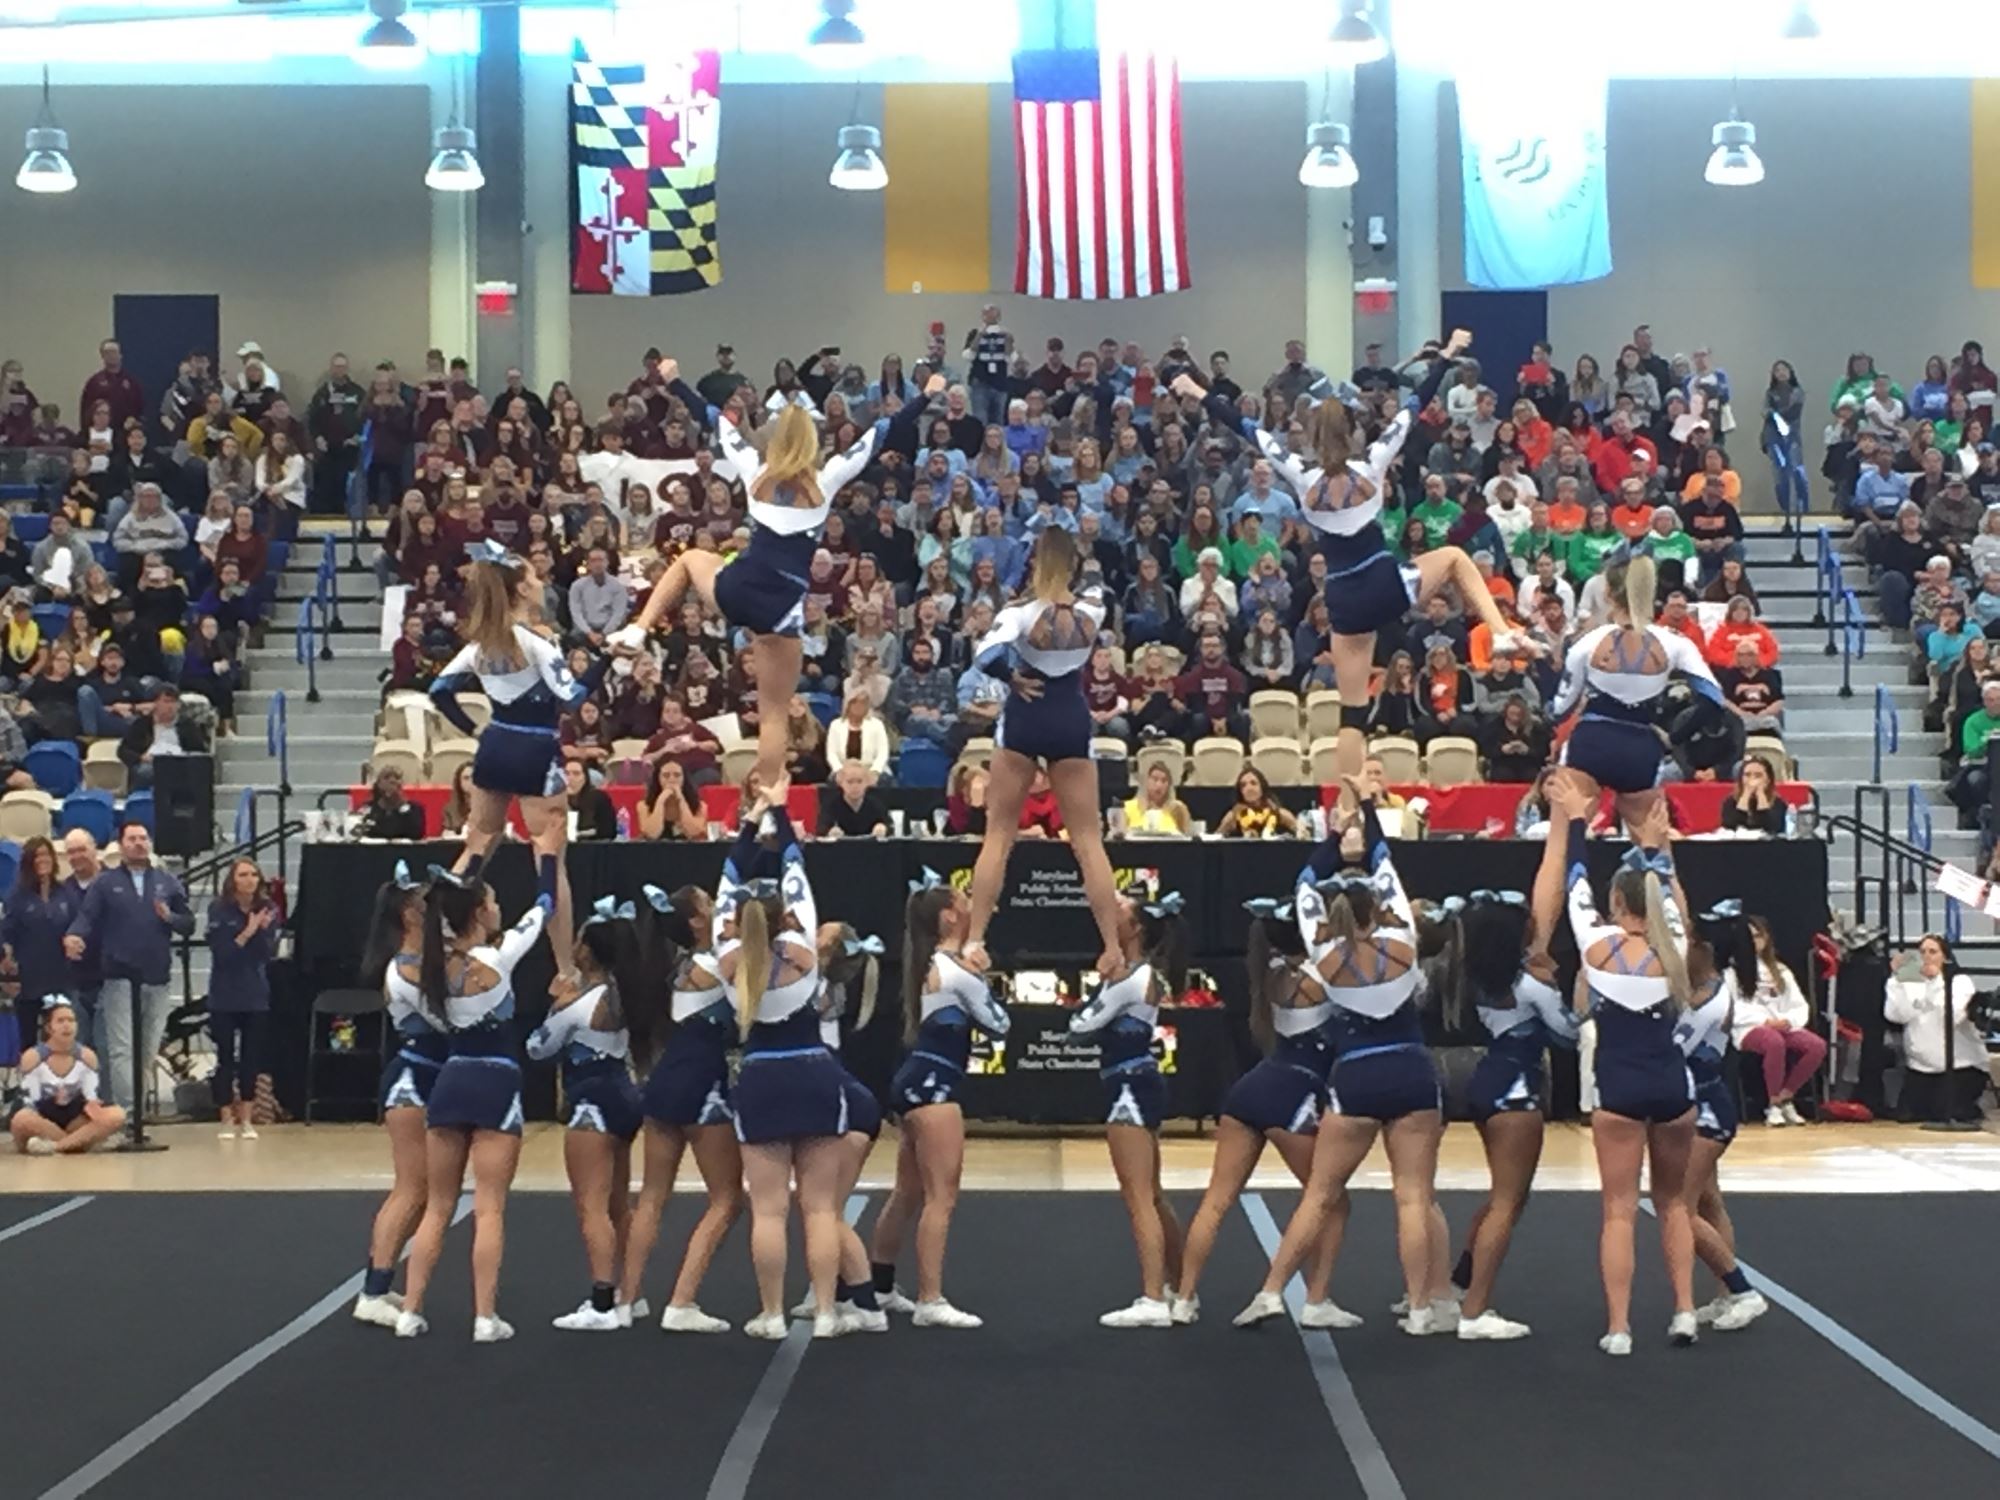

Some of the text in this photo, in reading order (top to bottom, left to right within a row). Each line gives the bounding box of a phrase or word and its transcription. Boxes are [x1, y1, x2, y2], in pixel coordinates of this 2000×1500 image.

[1031, 870, 1078, 883] Maryland
[1020, 883, 1051, 894] Public
[1010, 896, 1034, 907] State
[1041, 1029, 1068, 1043] Mary
[1027, 1044, 1102, 1055] Public Schools
[1017, 1058, 1044, 1069] State
